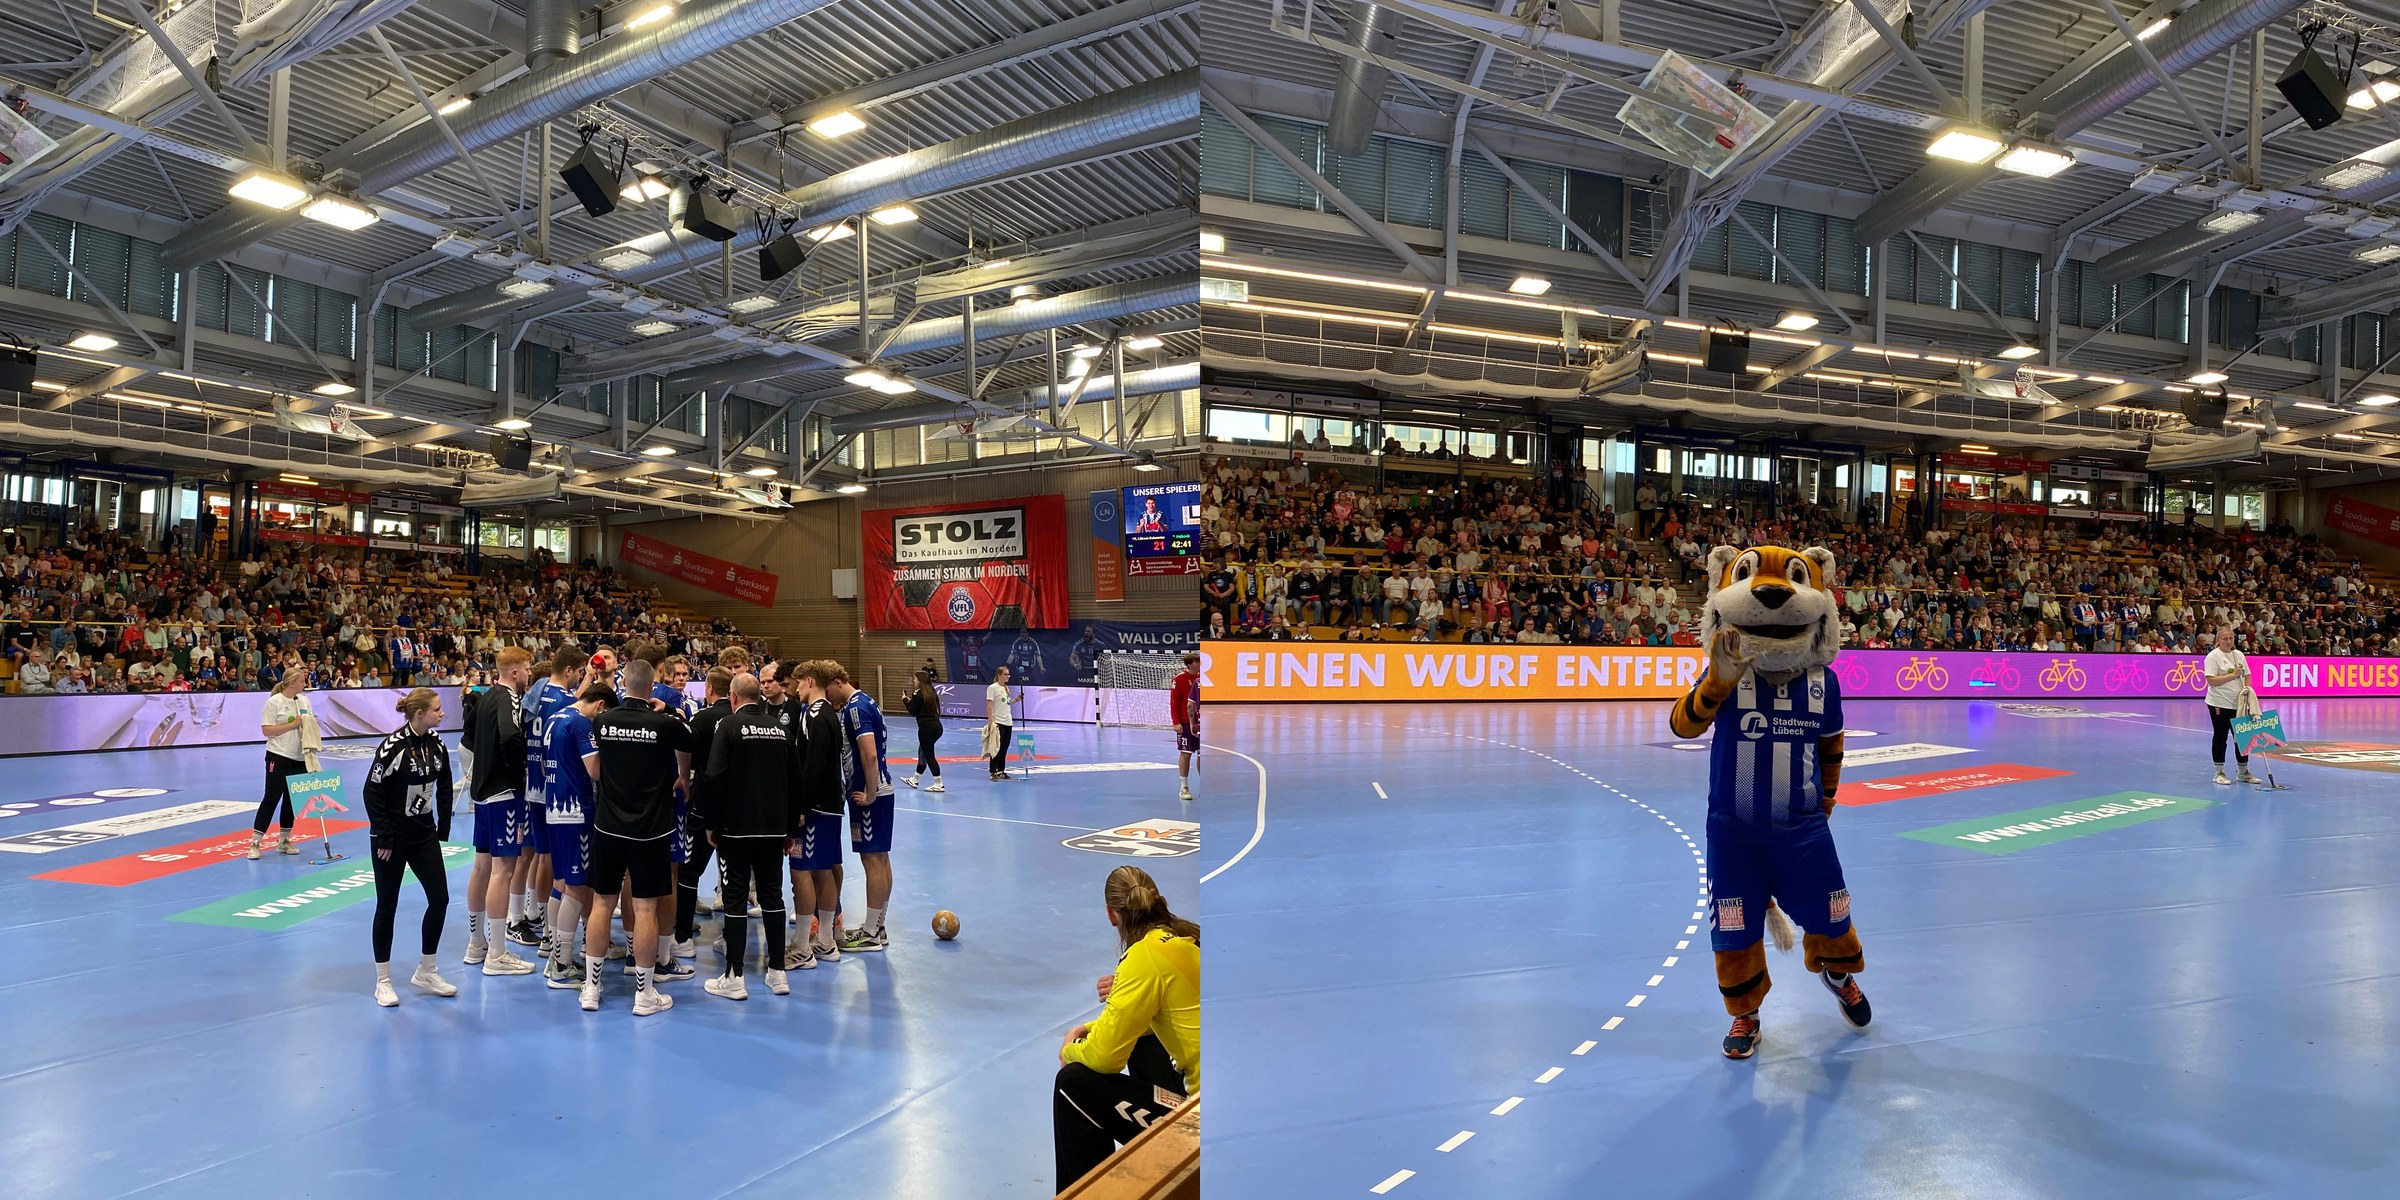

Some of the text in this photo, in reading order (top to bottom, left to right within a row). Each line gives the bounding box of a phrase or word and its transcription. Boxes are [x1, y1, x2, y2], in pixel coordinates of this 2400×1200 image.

[1332, 455, 1356, 464] Trinity
[1133, 487, 1165, 496] UNSERE
[1099, 508, 1111, 516] LN
[2345, 509, 2378, 526] Sparkasse
[900, 516, 1016, 545] STOLZ
[2342, 521, 2369, 534] Holstein
[902, 544, 1017, 558] Das Kaufhaus im Norden
[1153, 541, 1165, 551] 21
[1171, 540, 1192, 549] 42:41
[636, 545, 664, 560] Sparkasse
[633, 553, 657, 568] Holstein
[683, 560, 715, 576] Sparkasse
[893, 564, 1029, 581] ZUSAMMEN STARK IM NORDEN!
[681, 571, 708, 584] Holstein
[736, 576, 770, 593] Sparkasse
[734, 586, 762, 600] Holstein
[954, 604, 968, 612] VfL
[1118, 632, 1159, 645] WALL
[1162, 632, 1182, 644] OF
[1236, 653, 1386, 687] EINEN
[1404, 654, 1539, 688] WURF
[2262, 663, 2399, 688] DEIN NEUES
[1772, 717, 1821, 729] Stadtwerke
[543, 721, 555, 750] 4
[609, 725, 657, 740] Bauche
[749, 725, 786, 737] Bauche
[1772, 727, 1805, 736] Lübeck
[1905, 771, 1992, 787] Sparkasse
[1955, 796, 2177, 843] www.unizell.de
[1716, 898, 1743, 909] FRANKE
[1718, 908, 1743, 920] HOME
